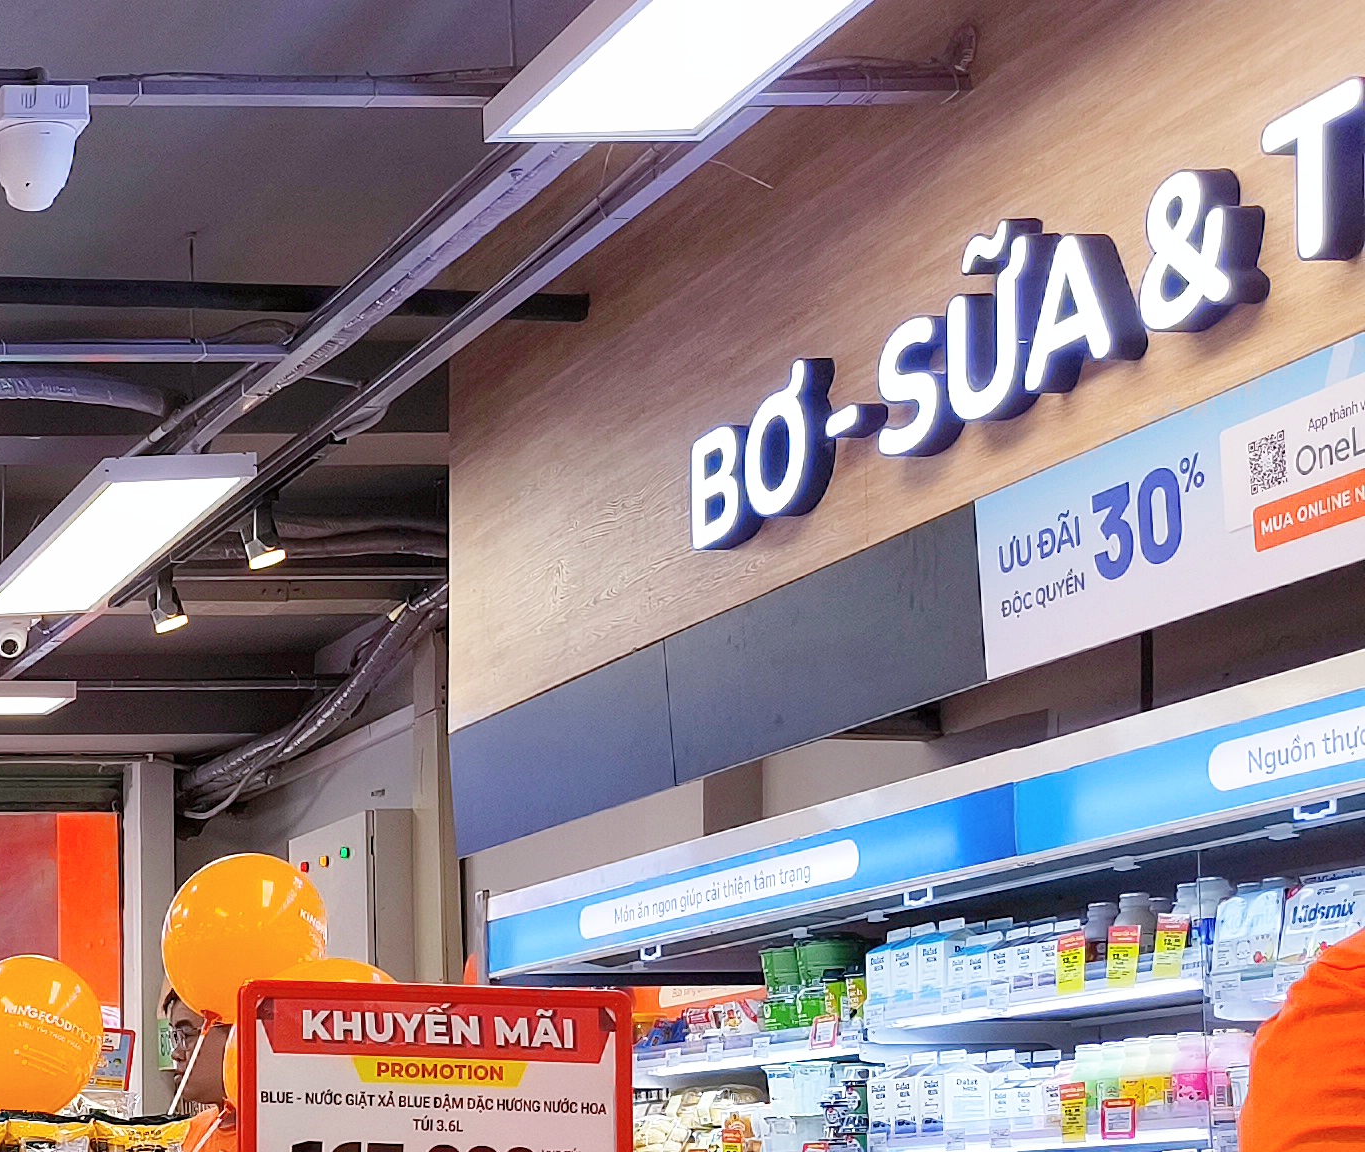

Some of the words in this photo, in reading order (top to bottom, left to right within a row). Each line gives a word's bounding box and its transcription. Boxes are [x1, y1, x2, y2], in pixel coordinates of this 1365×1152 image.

[1140, 171, 1231, 331] &
[1308, 417, 1328, 433] App
[1091, 452, 1205, 580] 30%
[1260, 514, 1294, 535] MUA
[1296, 493, 1352, 522] ONLINE
[999, 536, 1032, 573] ƯU
[1037, 511, 1081, 560] ĐÃI
[1001, 590, 1033, 618] ĐỘC
[1036, 569, 1085, 607] QUYỀN
[1248, 735, 1315, 774] Nguồn
[615, 902, 635, 925] Món
[680, 888, 702, 912] giúp
[754, 871, 776, 891] tâm
[780, 864, 811, 888] trạng
[302, 1003, 480, 1048] KHUYẾN
[495, 1009, 574, 1049] MÃI
[376, 1061, 503, 1081] PROMOTION
